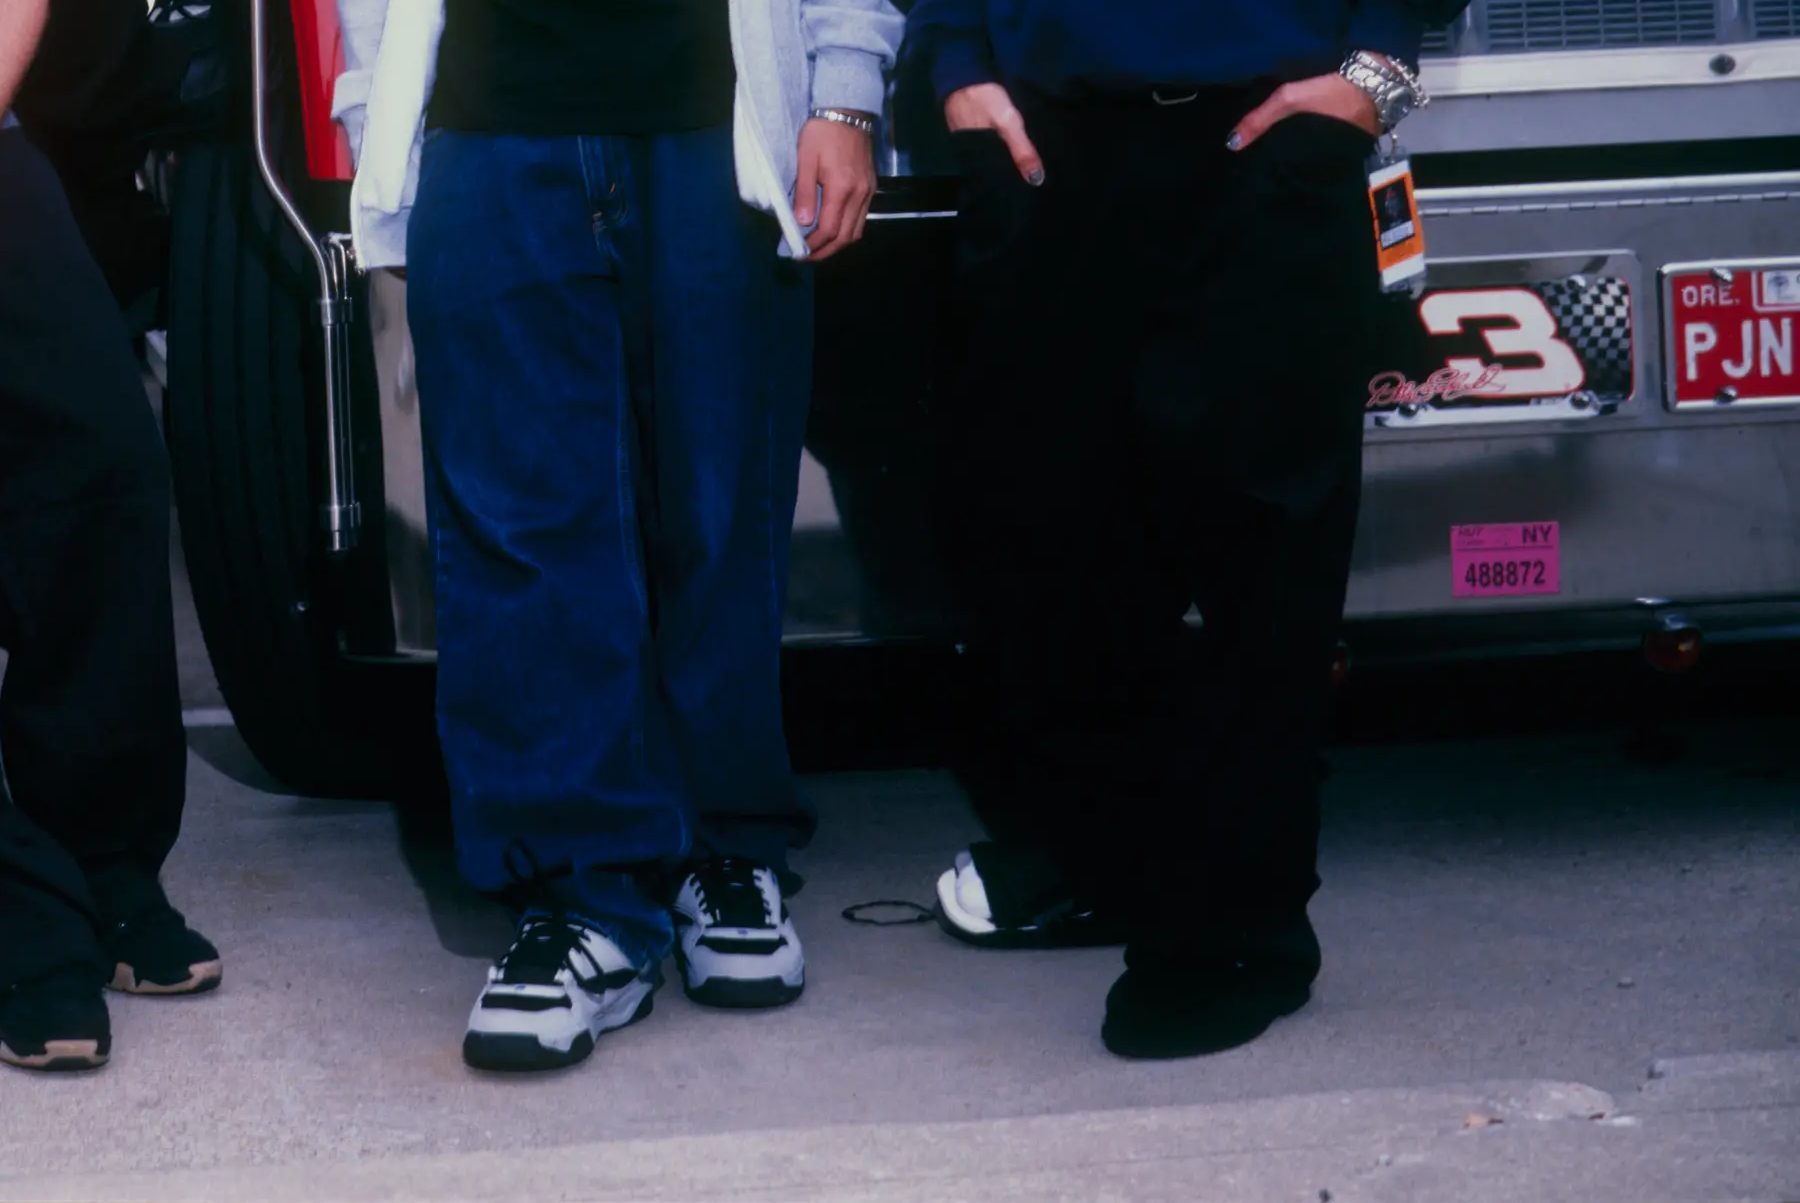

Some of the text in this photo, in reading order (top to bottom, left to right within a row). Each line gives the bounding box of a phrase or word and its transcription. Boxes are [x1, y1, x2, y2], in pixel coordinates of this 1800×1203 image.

[1419, 286, 1585, 398] 3
[1684, 317, 1792, 382] PJN
[1522, 524, 1552, 544] NY
[1464, 560, 1546, 588] 488872
